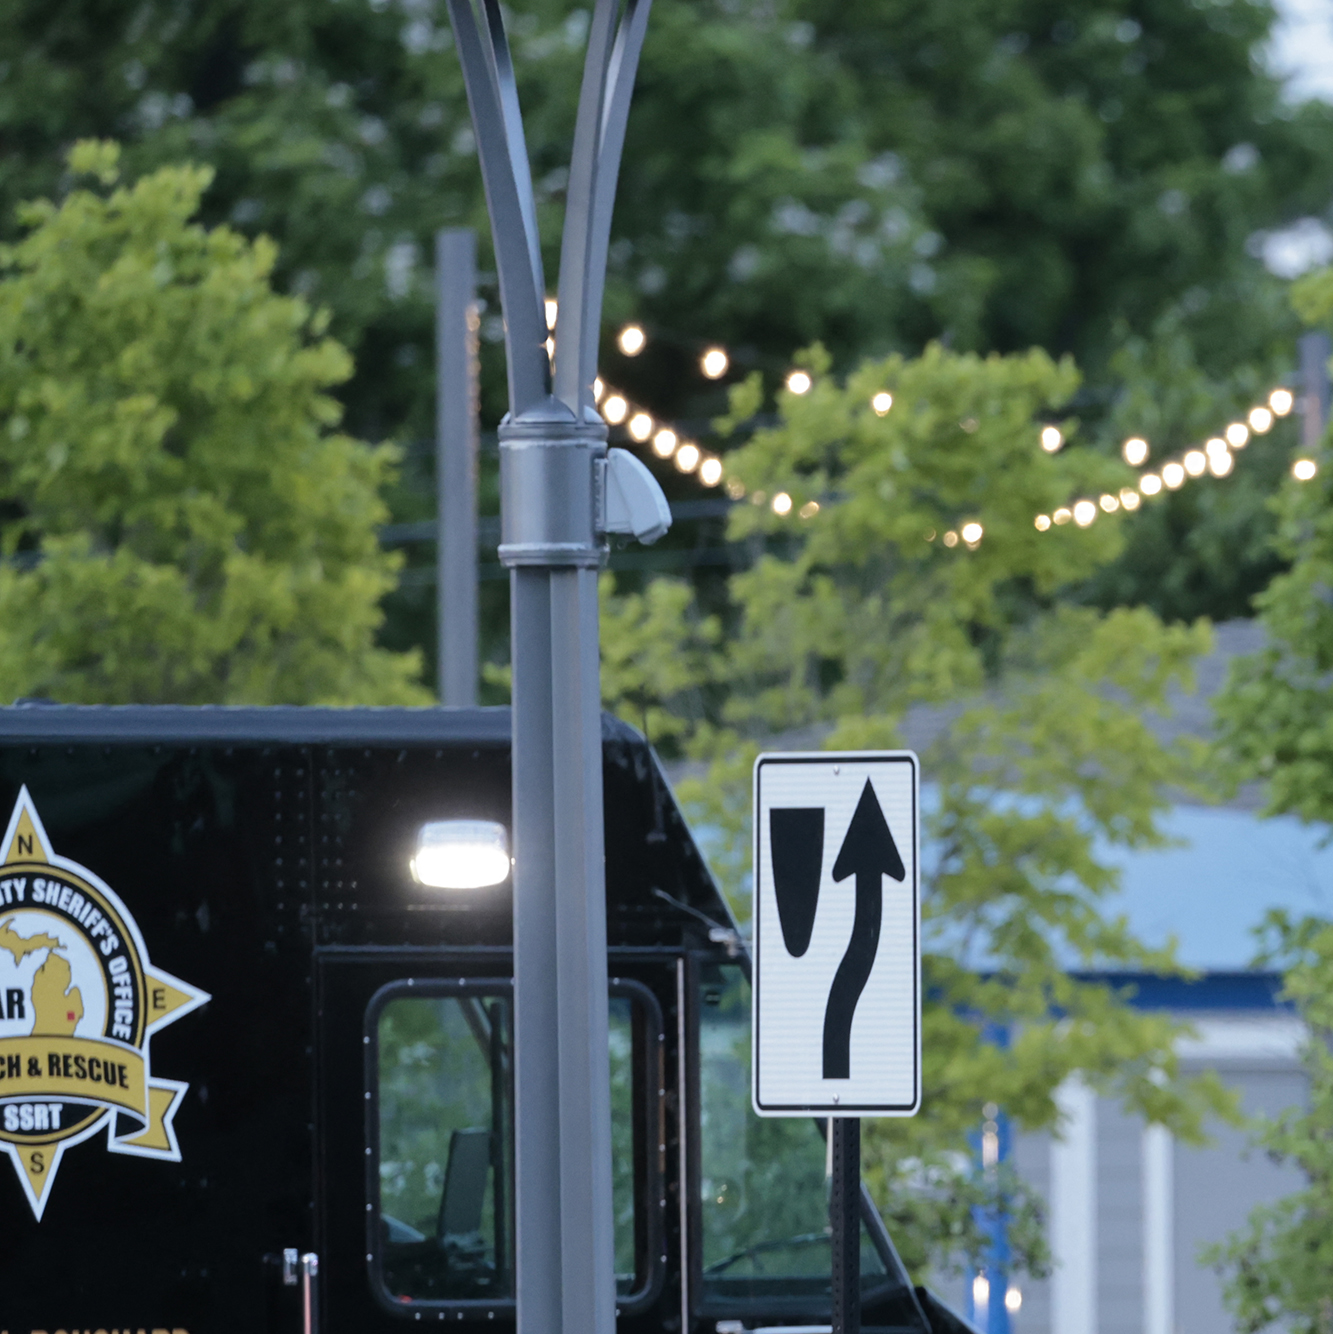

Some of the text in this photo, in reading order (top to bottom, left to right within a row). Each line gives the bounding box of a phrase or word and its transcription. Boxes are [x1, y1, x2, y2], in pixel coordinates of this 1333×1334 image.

[18, 835, 33, 854] N
[32, 877, 119, 956] SHERIFF'S
[108, 955, 134, 1041] OFFICE
[0, 988, 26, 1020] R
[153, 988, 166, 1010] E
[27, 1056, 42, 1077] &
[48, 1053, 129, 1090] RESCUE
[3, 1103, 63, 1132] SSRT
[30, 1152, 45, 1174] S
